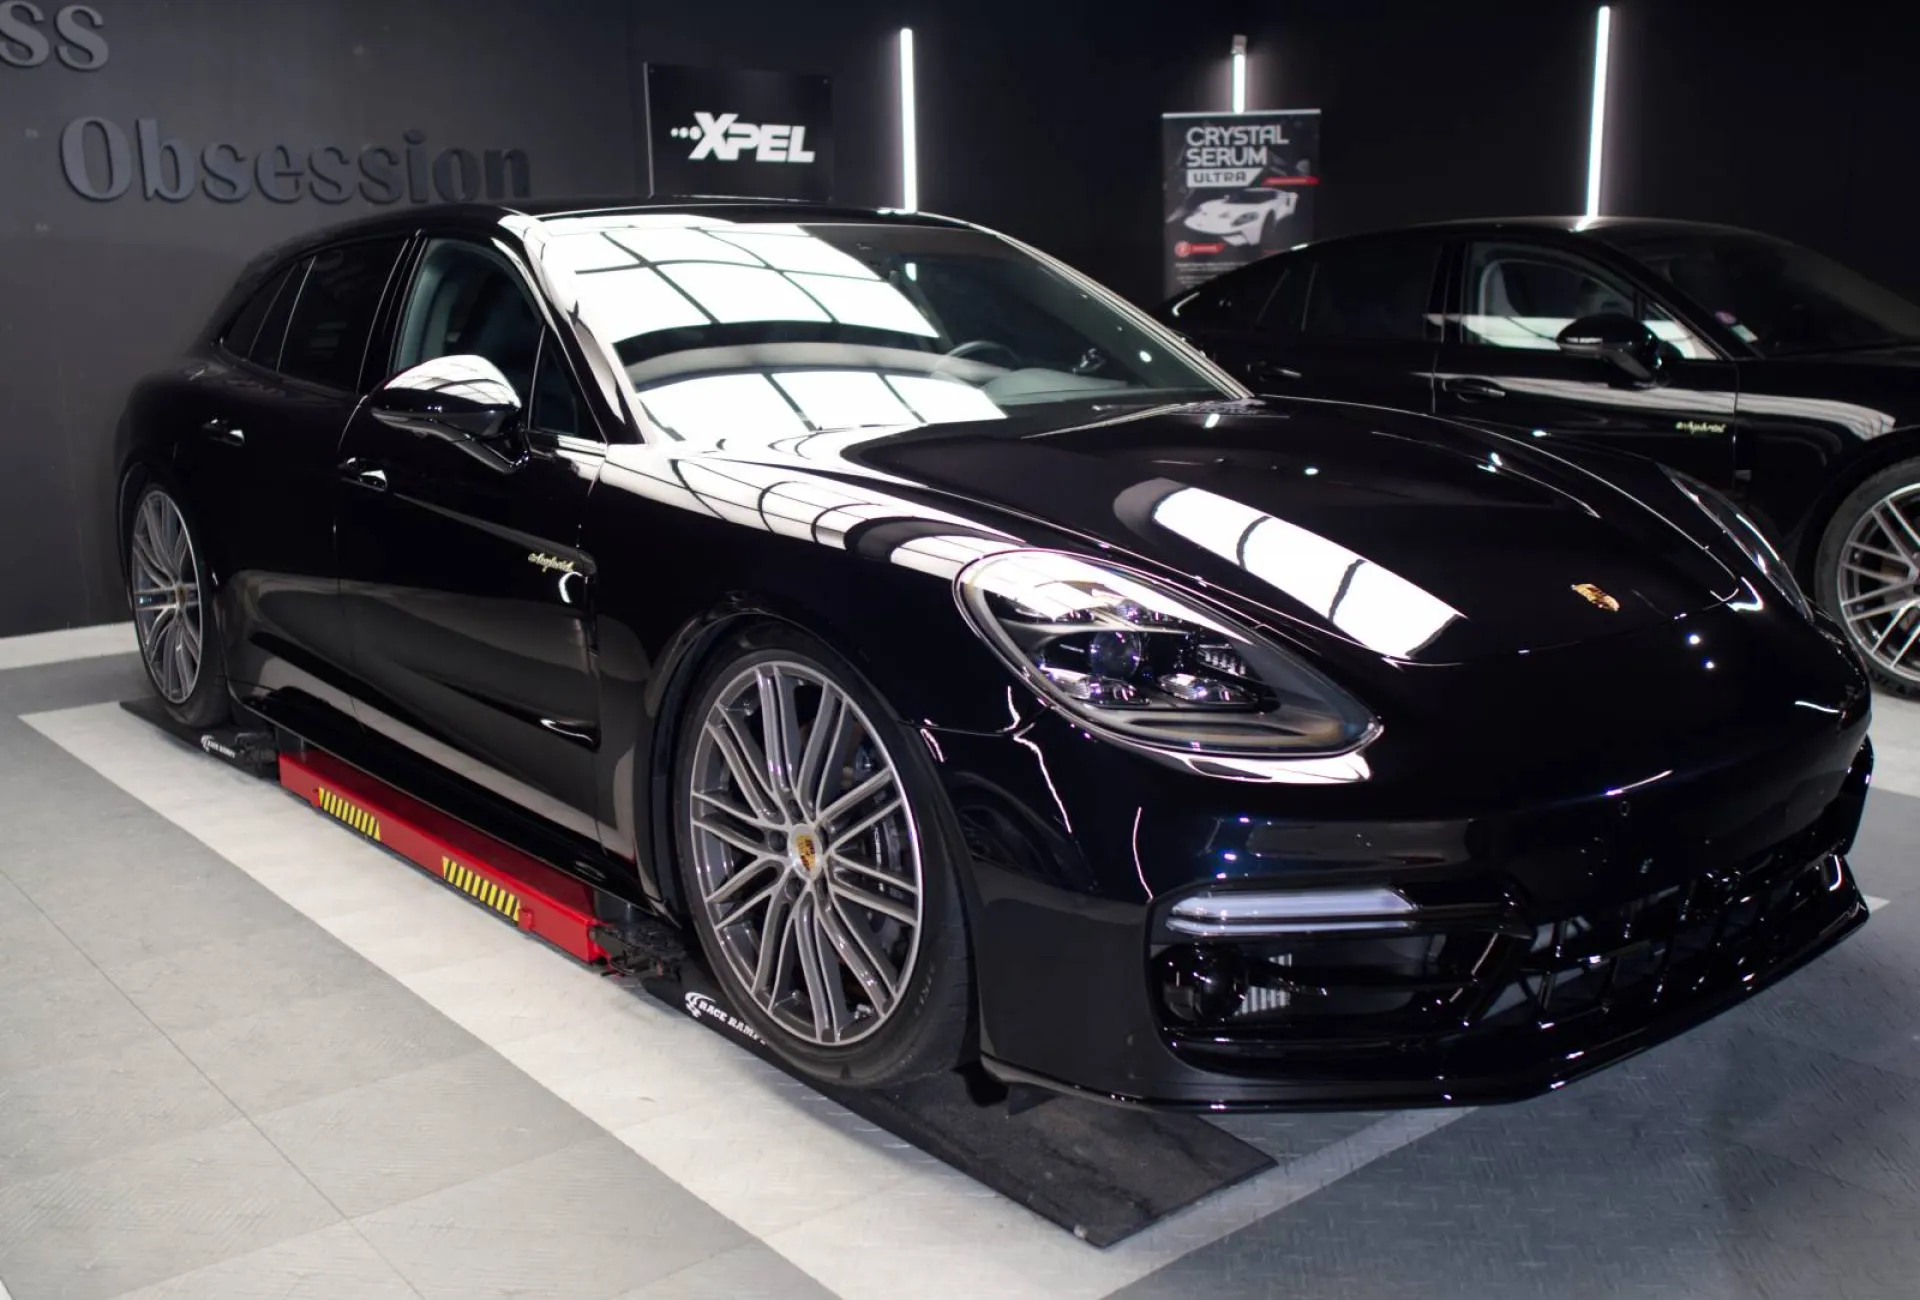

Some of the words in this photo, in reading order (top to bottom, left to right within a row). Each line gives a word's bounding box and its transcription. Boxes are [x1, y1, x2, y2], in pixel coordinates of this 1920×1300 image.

[687, 111, 815, 163] XPEL
[1186, 125, 1289, 146] CRYSTAL
[60, 115, 530, 204] Obsession
[1186, 147, 1268, 168] SERUM
[1193, 171, 1247, 183] ULTRA
[699, 1001, 728, 1021] RACE
